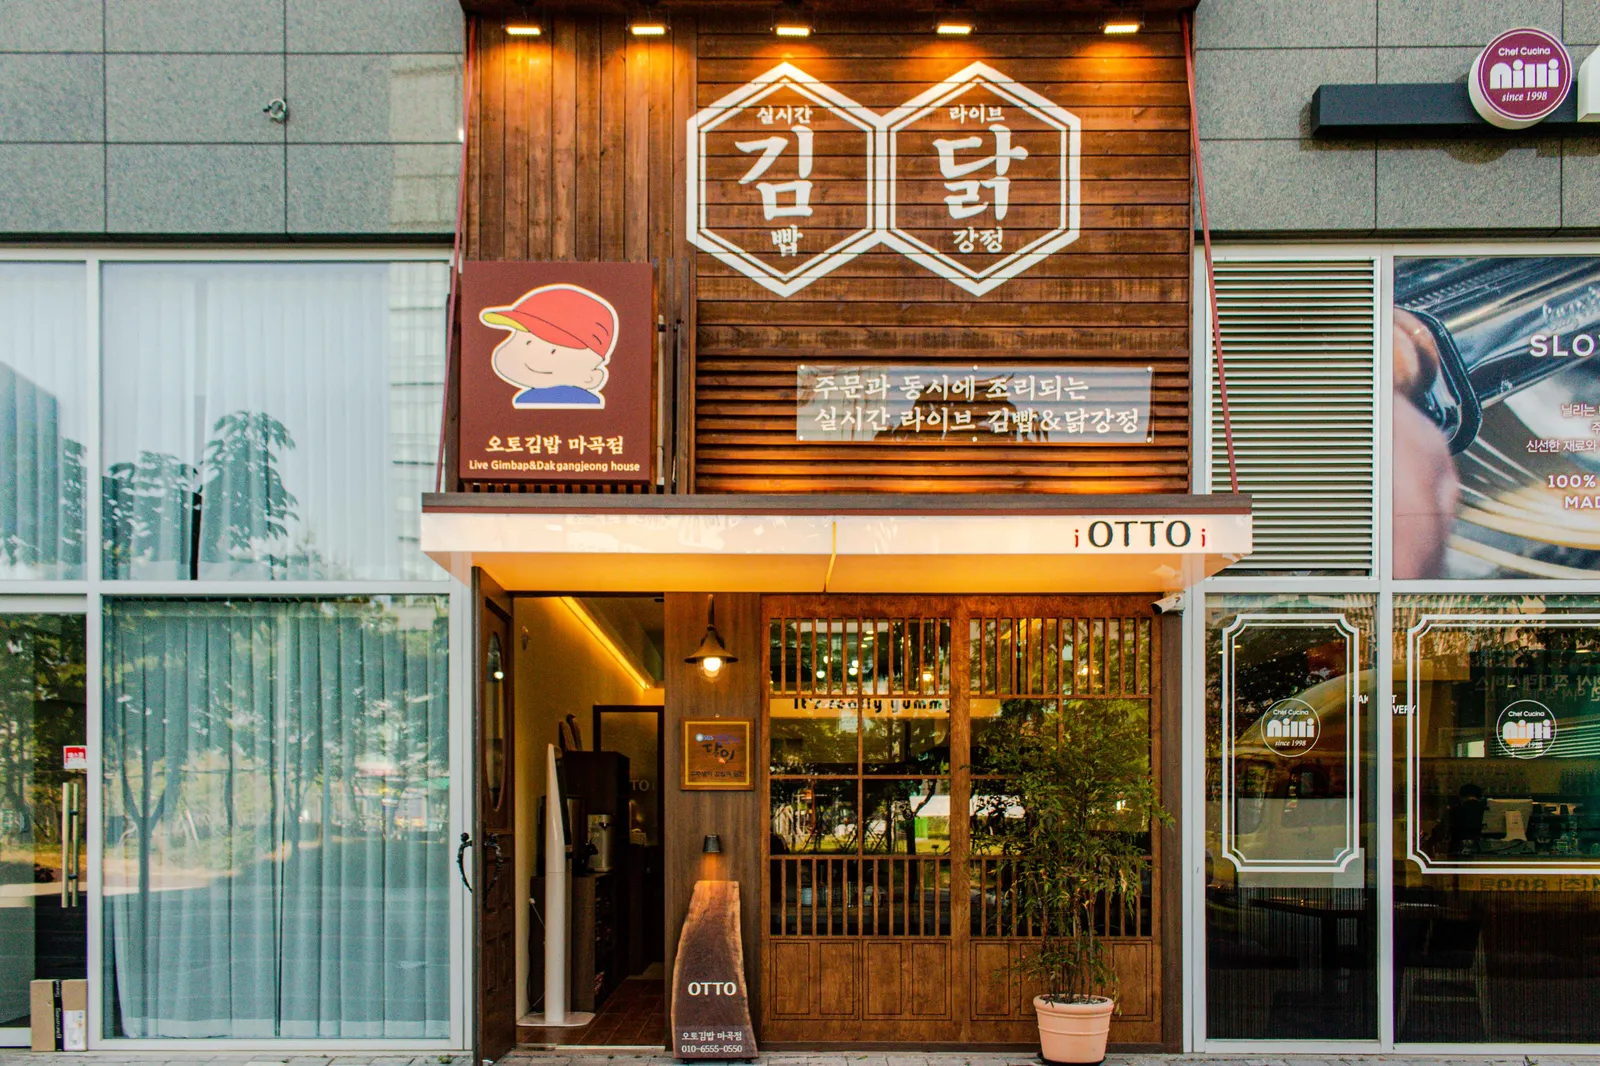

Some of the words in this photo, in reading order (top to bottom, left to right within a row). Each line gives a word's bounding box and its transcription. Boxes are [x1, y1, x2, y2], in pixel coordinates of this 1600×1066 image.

[1498, 47, 1519, 56] Chef
[1520, 46, 1551, 56] Cucina
[1502, 92, 1524, 102] since
[1526, 91, 1548, 101] 1998
[757, 105, 813, 125] 실시간
[949, 103, 1005, 124] 라이브
[735, 125, 814, 221] 김
[932, 124, 1029, 221] 닭
[952, 226, 1004, 253] 강정
[1529, 334, 1600, 357] SLO
[813, 374, 891, 399] 주문과
[900, 374, 976, 401] 동시에
[986, 375, 1089, 401] 조리되는
[814, 406, 890, 432] 실시간
[900, 406, 976, 433] 라이브
[485, 435, 562, 454] 오토김밥
[568, 435, 624, 455] 마곡점
[1526, 440, 1560, 453] 신선한
[1563, 440, 1596, 453] 재료와
[469, 460, 488, 470] Live
[610, 461, 640, 471] house
[1548, 475, 1596, 488] 100%
[1088, 520, 1191, 548] OTTO
[688, 982, 737, 996] OTTO
[682, 1031, 715, 1041] 오토김밥
[717, 1031, 742, 1041] 마곡점
